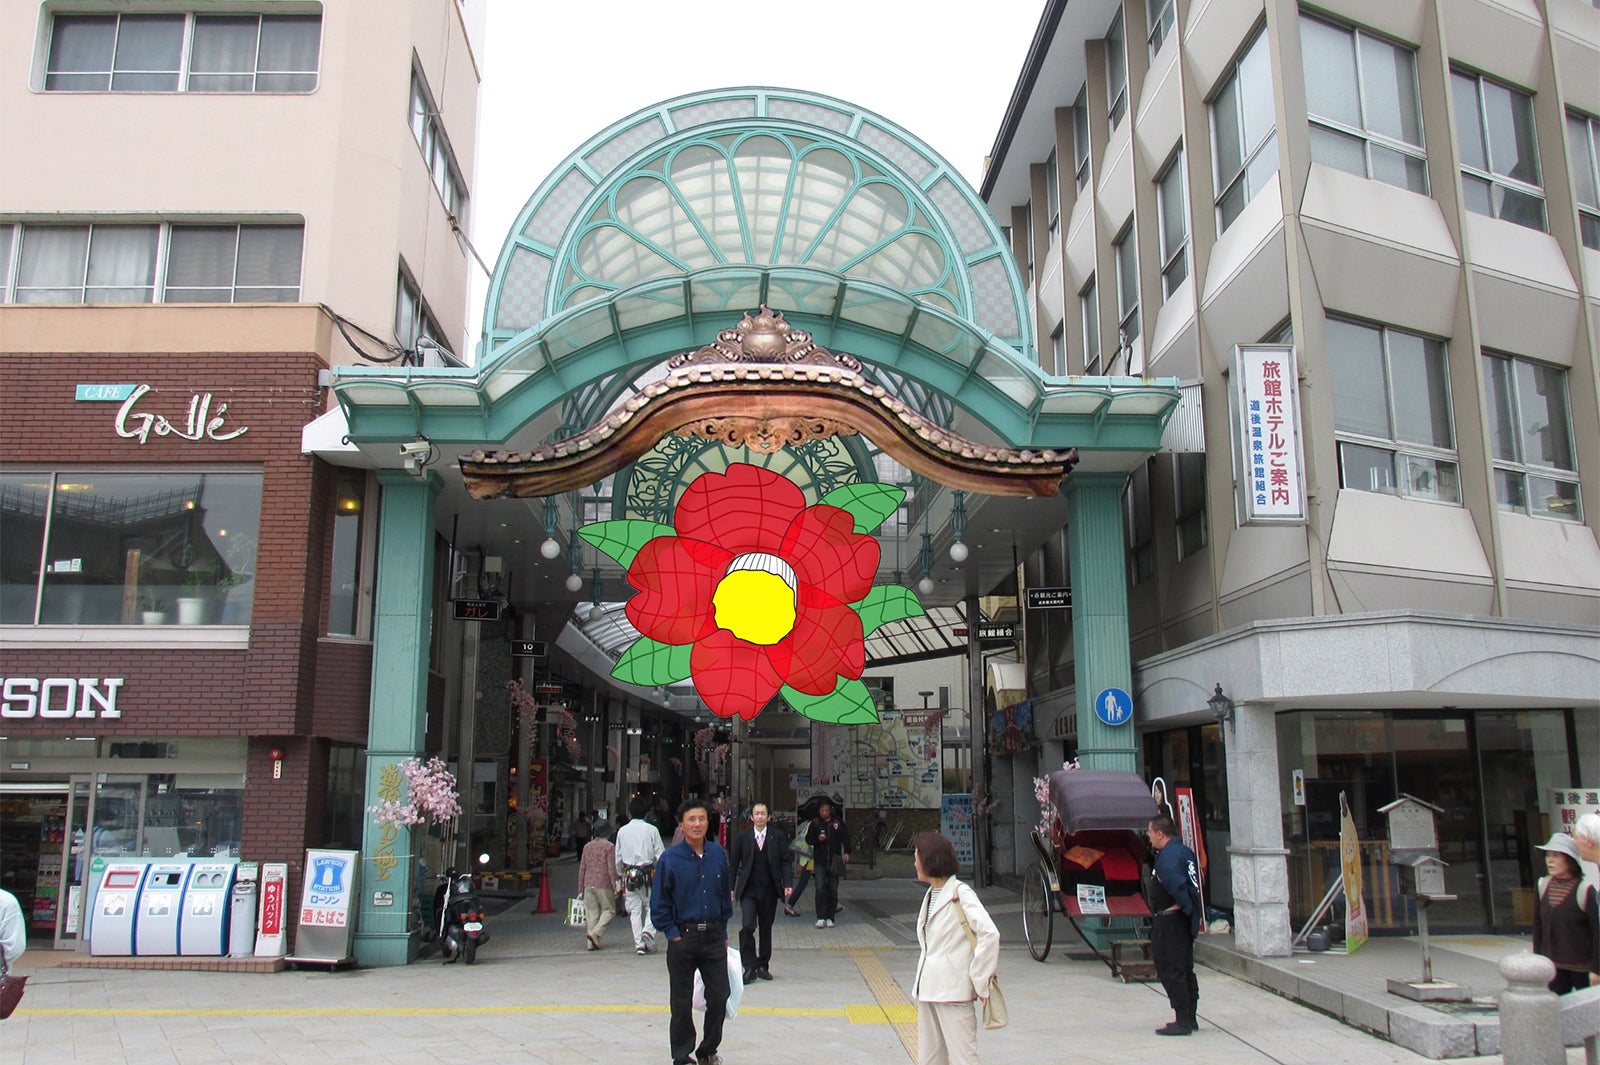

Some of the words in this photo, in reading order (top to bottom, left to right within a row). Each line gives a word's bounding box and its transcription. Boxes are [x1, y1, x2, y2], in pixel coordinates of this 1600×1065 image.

[1249, 400, 1267, 506] 道後温泉旅館組合
[1262, 360, 1290, 506] 旅館ホテルご案内
[0, 678, 124, 718] SON
[316, 859, 346, 868] LAWSON
[310, 895, 340, 905] ローソン
